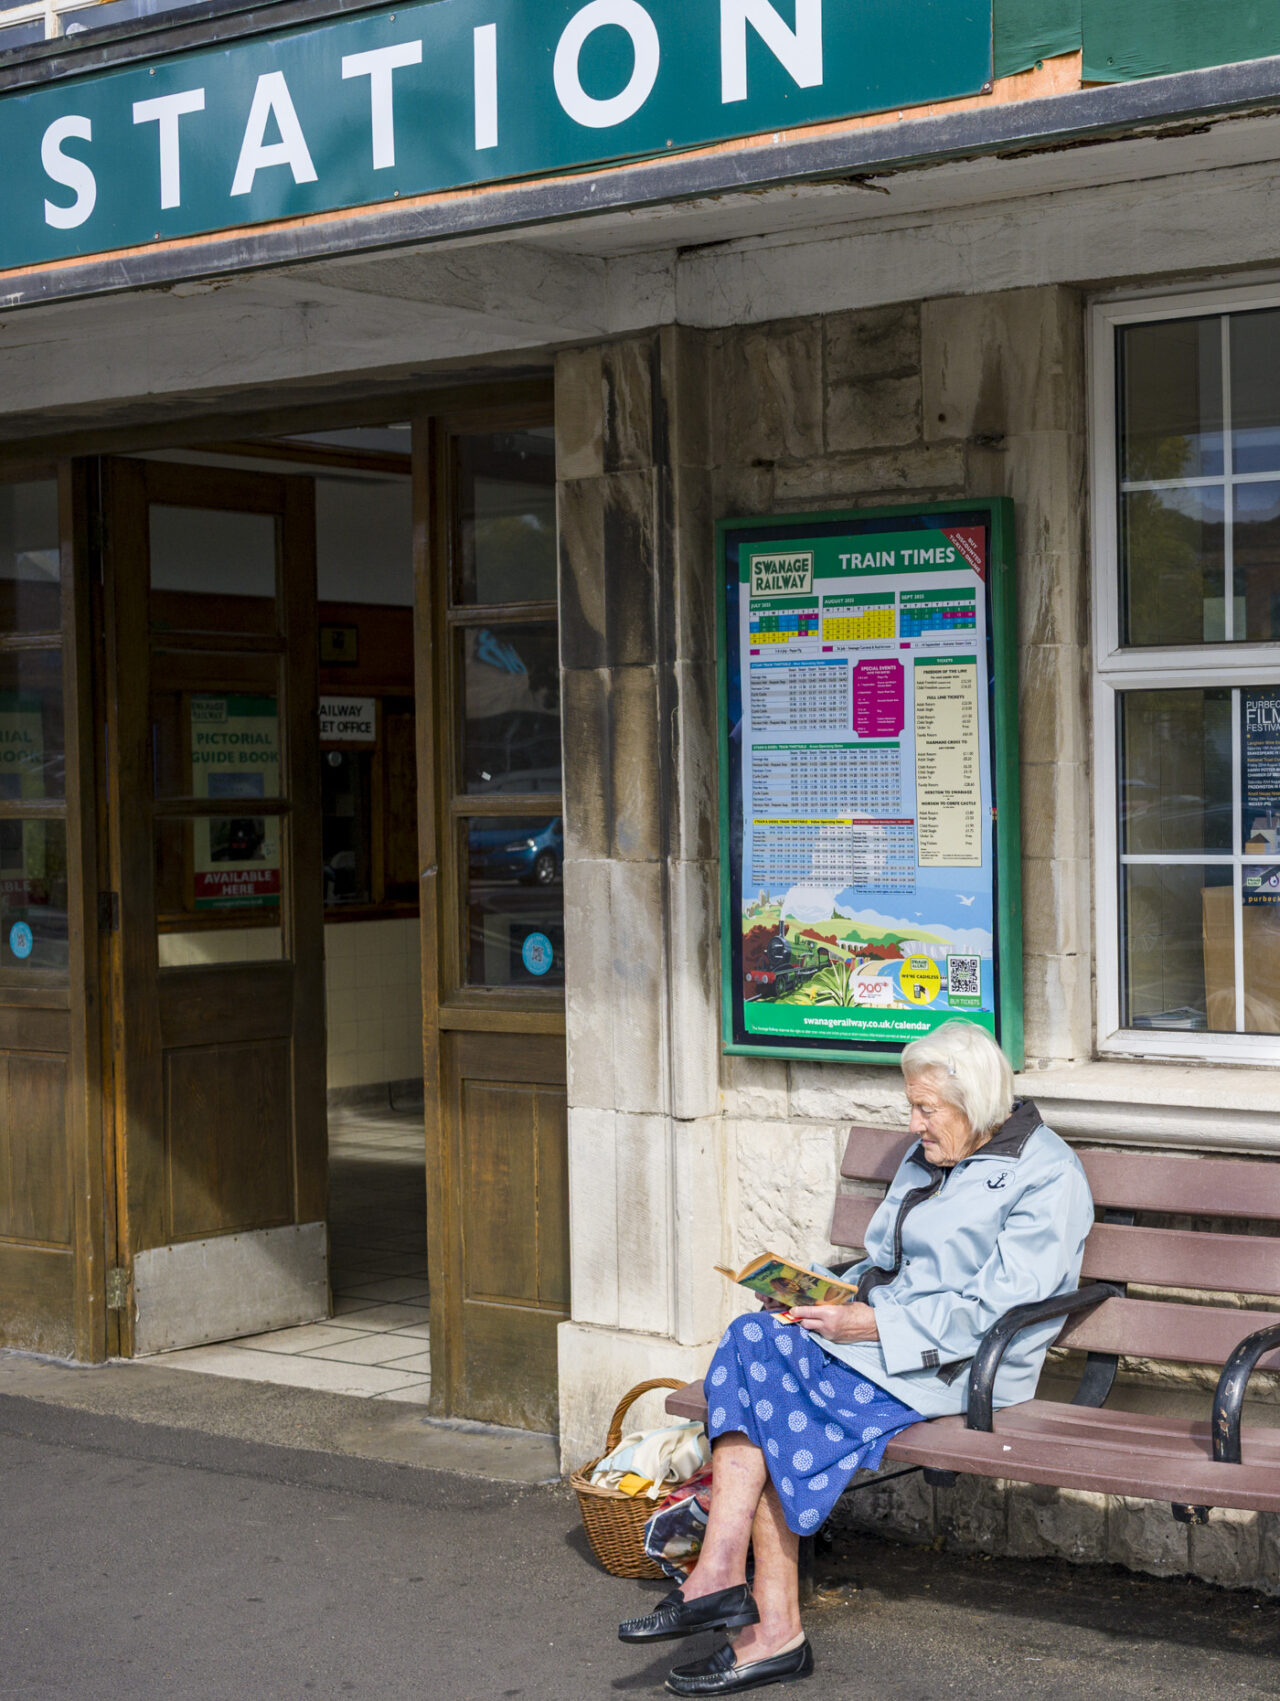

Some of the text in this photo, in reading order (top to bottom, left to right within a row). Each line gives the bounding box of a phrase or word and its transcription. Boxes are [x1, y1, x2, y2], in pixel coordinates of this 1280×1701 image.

[41, 0, 823, 229] STATION
[956, 533, 982, 564] DISCOUNTED
[968, 537, 978, 548] BUY
[838, 547, 956, 570] TRAIN TIMES
[949, 534, 981, 572] TICKETS ONLINE
[754, 557, 809, 575] SWANAGE
[756, 574, 806, 592] RAILWAY
[320, 704, 363, 717] AILWAY
[337, 721, 372, 733] OFFICE
[197, 733, 272, 744] PICTORIAL
[192, 751, 279, 762] GUIDE BOOK
[204, 870, 272, 885] AVAILABLE
[221, 883, 256, 896] HERE
[803, 1017, 931, 1031] swanagerailway.co.uk/calendar
